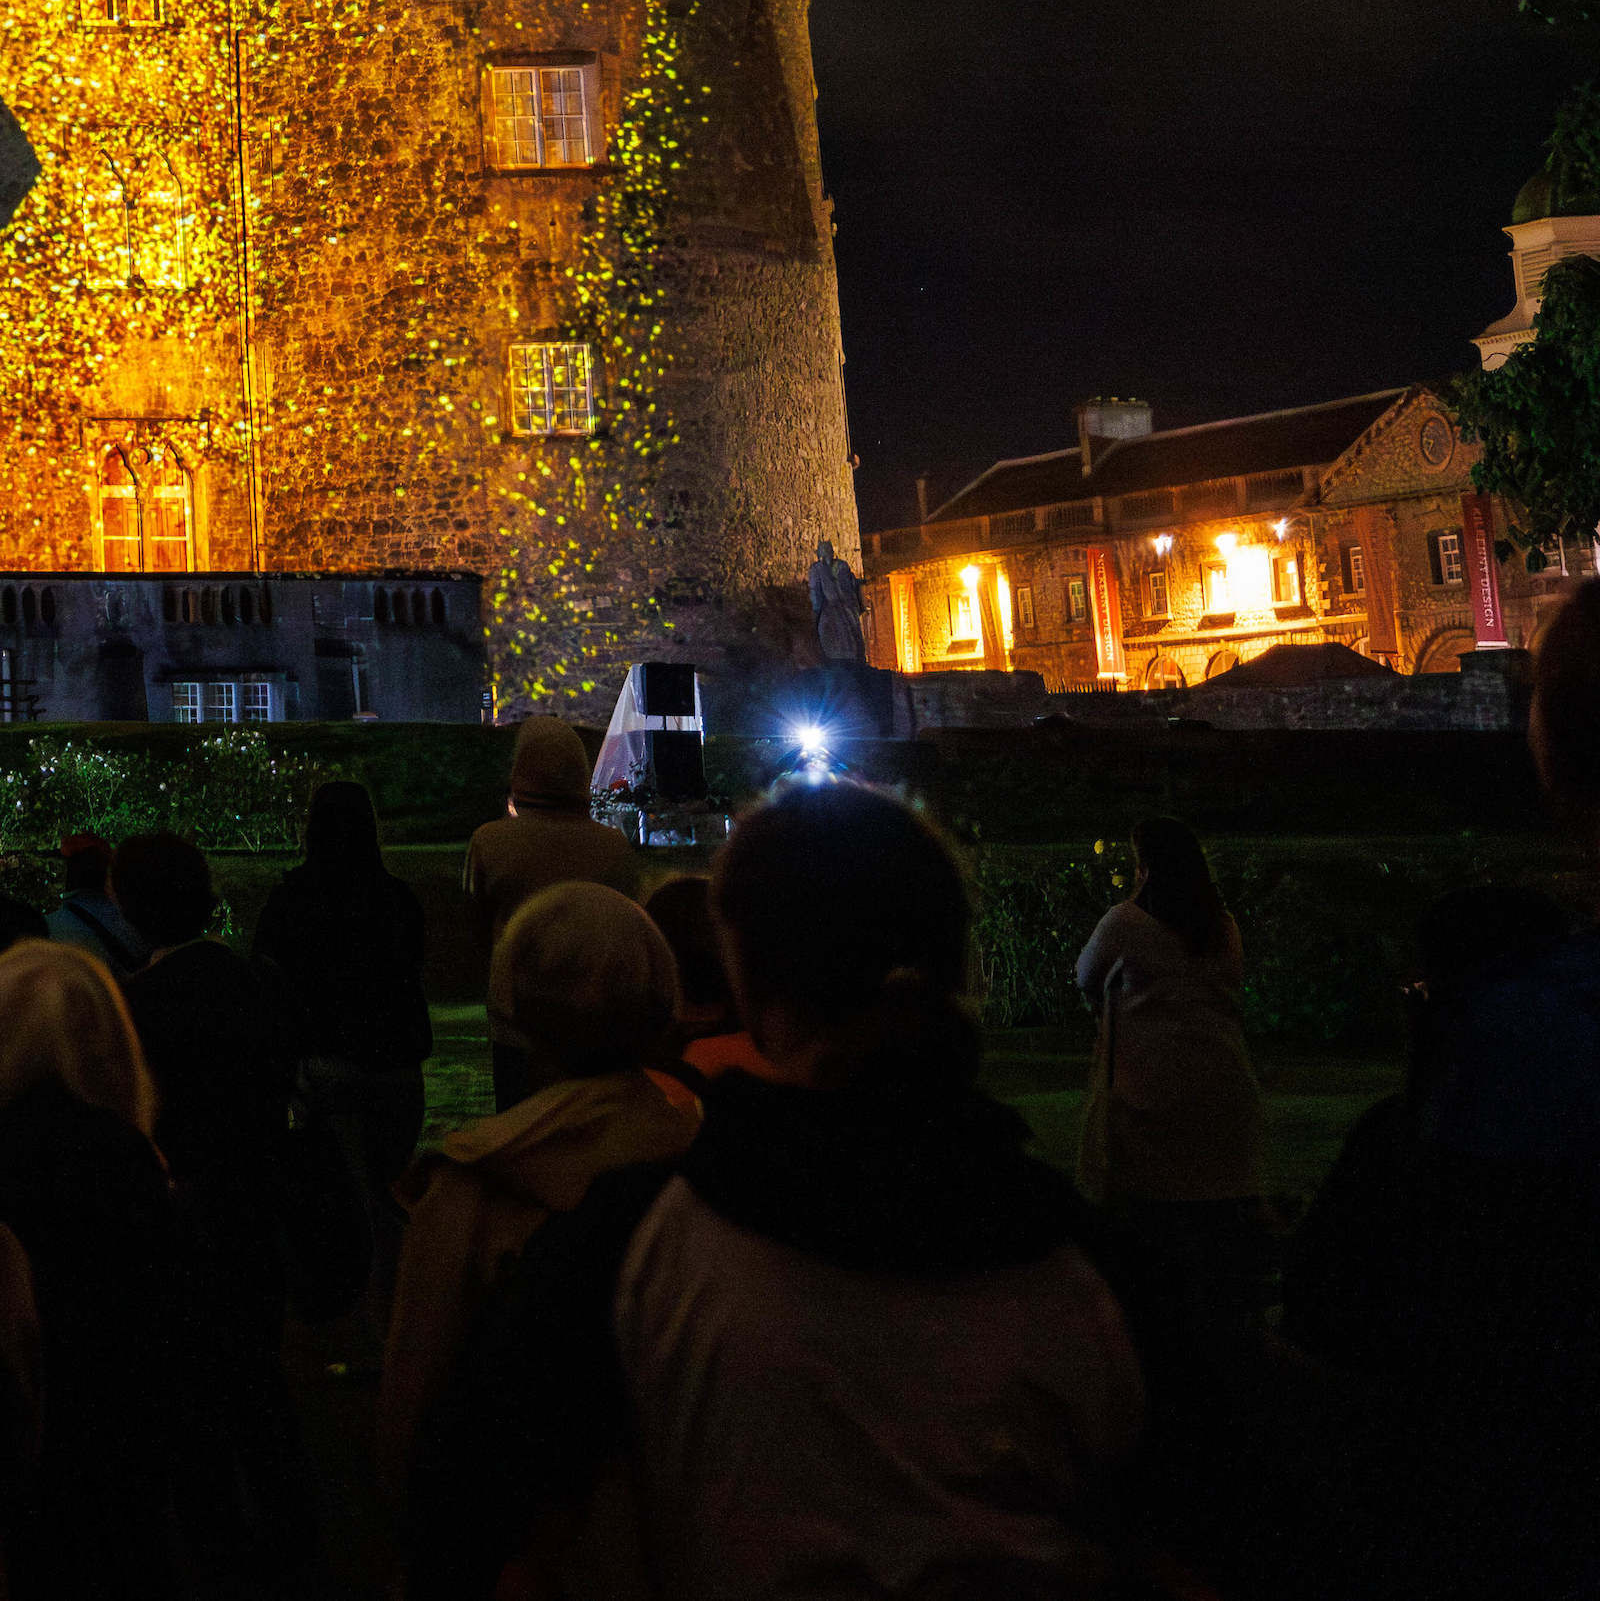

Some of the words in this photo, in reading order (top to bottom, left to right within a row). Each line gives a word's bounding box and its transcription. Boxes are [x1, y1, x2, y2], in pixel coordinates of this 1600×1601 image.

[1097, 558, 1108, 613] KILKENNY
[1480, 578, 1495, 627] DESIGN
[1102, 619, 1114, 660] DESIGN
